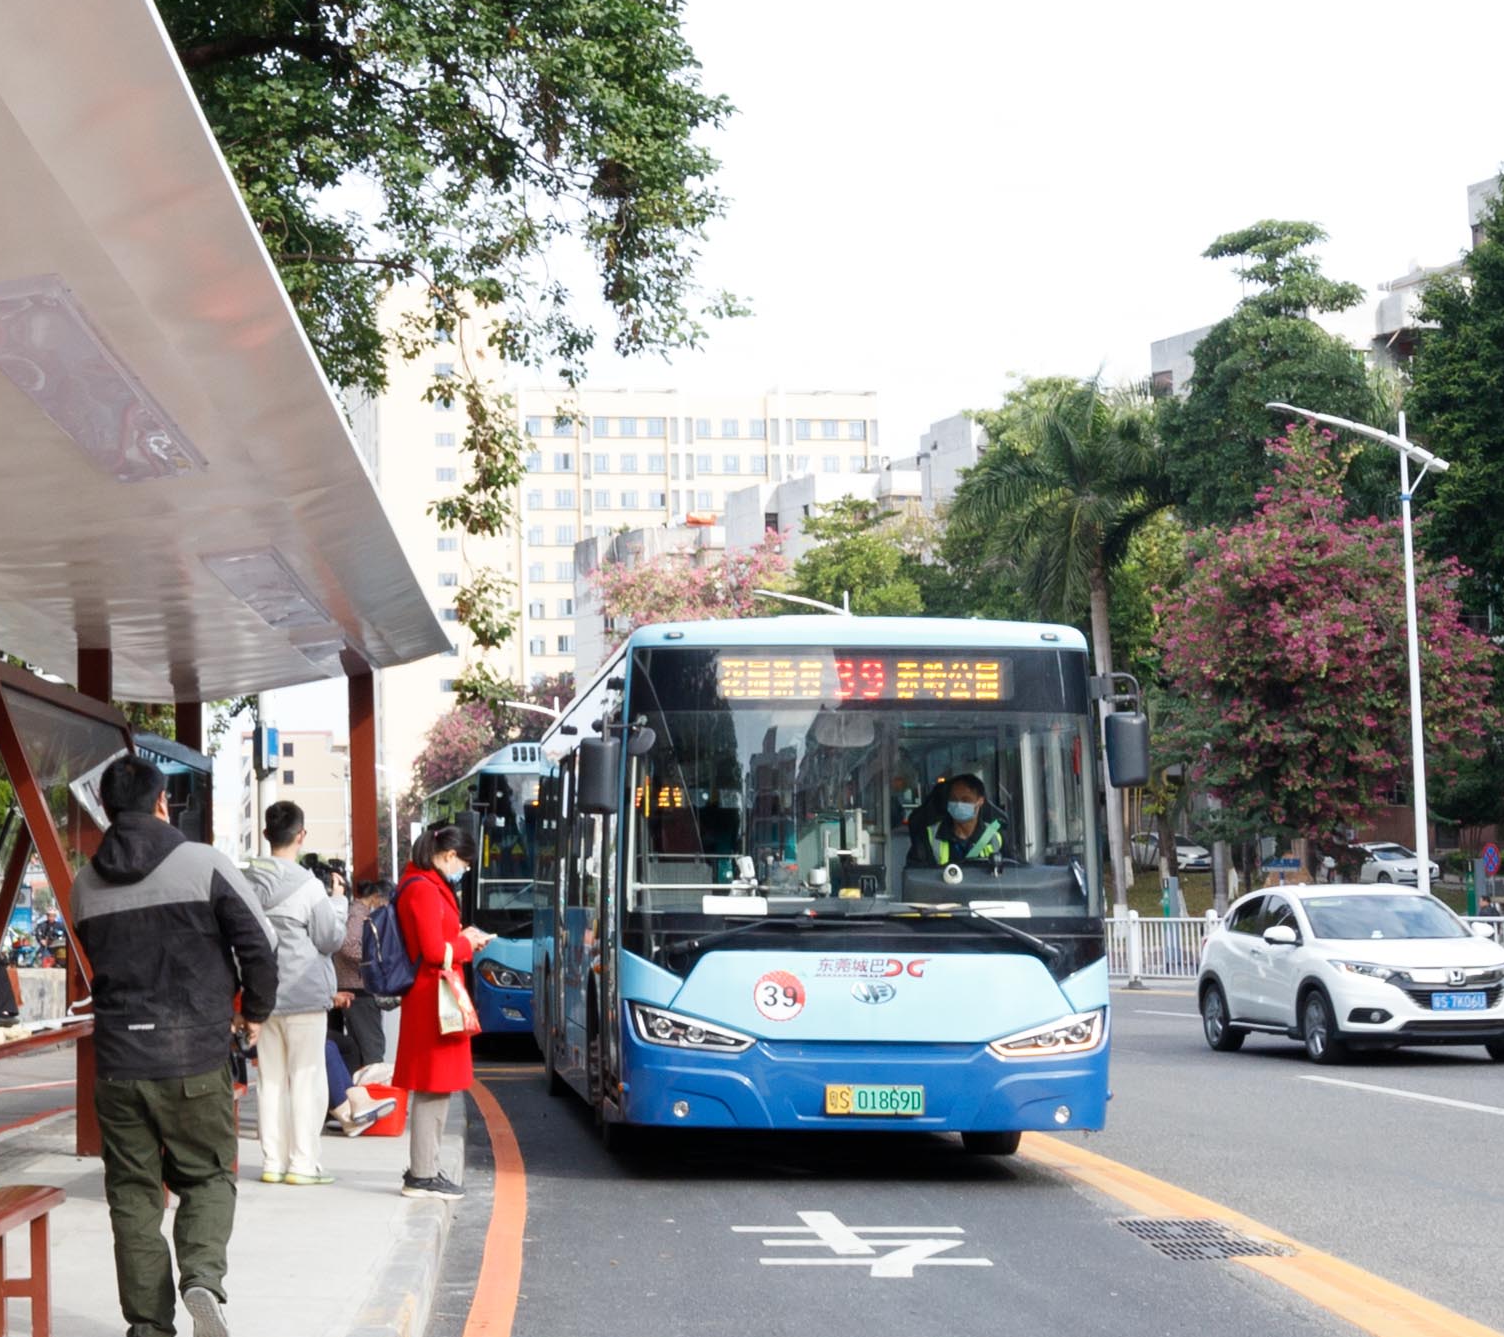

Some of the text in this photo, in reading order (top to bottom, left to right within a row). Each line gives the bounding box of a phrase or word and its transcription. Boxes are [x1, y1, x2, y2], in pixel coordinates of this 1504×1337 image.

[834, 662, 884, 697] 39
[817, 958, 885, 973] 东莞城巴
[763, 985, 798, 1008] 39
[858, 1090, 922, 1111] 01869D
